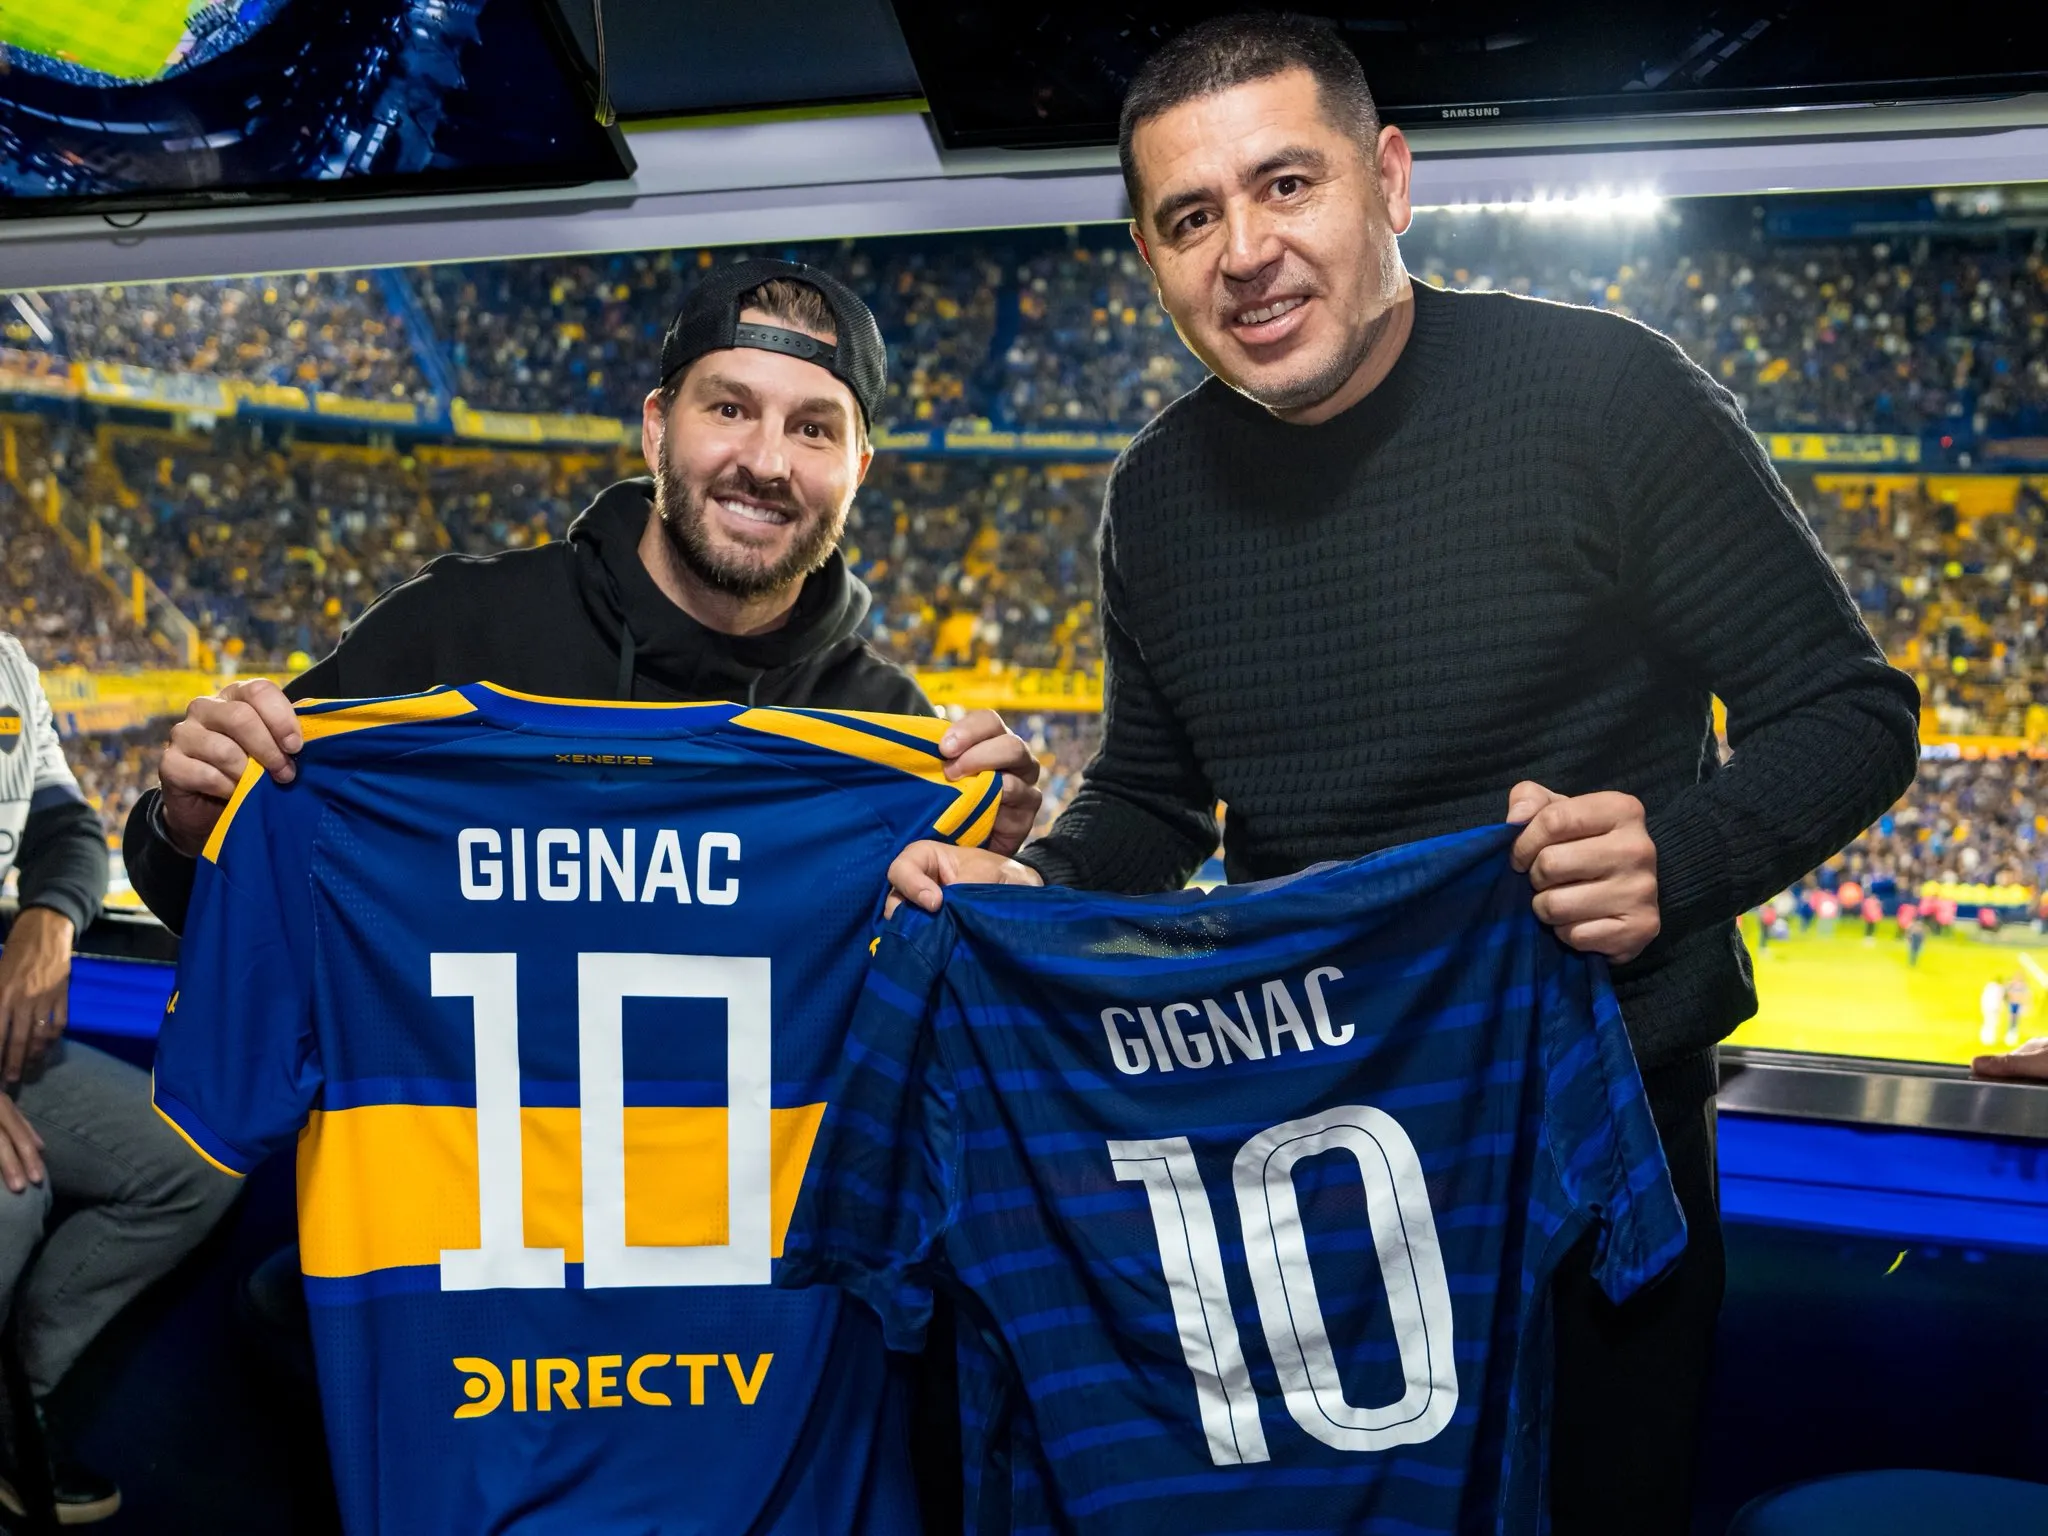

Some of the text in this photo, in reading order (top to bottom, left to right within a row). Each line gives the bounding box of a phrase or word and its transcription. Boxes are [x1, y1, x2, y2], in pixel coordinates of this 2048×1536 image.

[1442, 107, 1500, 118] SAMSUNG
[555, 754, 653, 765] XENEIZE
[457, 827, 741, 906] GIGNAC
[1100, 966, 1355, 1075] GIGNAC
[430, 951, 772, 1291] 10
[1106, 1104, 1459, 1466] 10
[453, 1353, 774, 1419] DIRECTV
